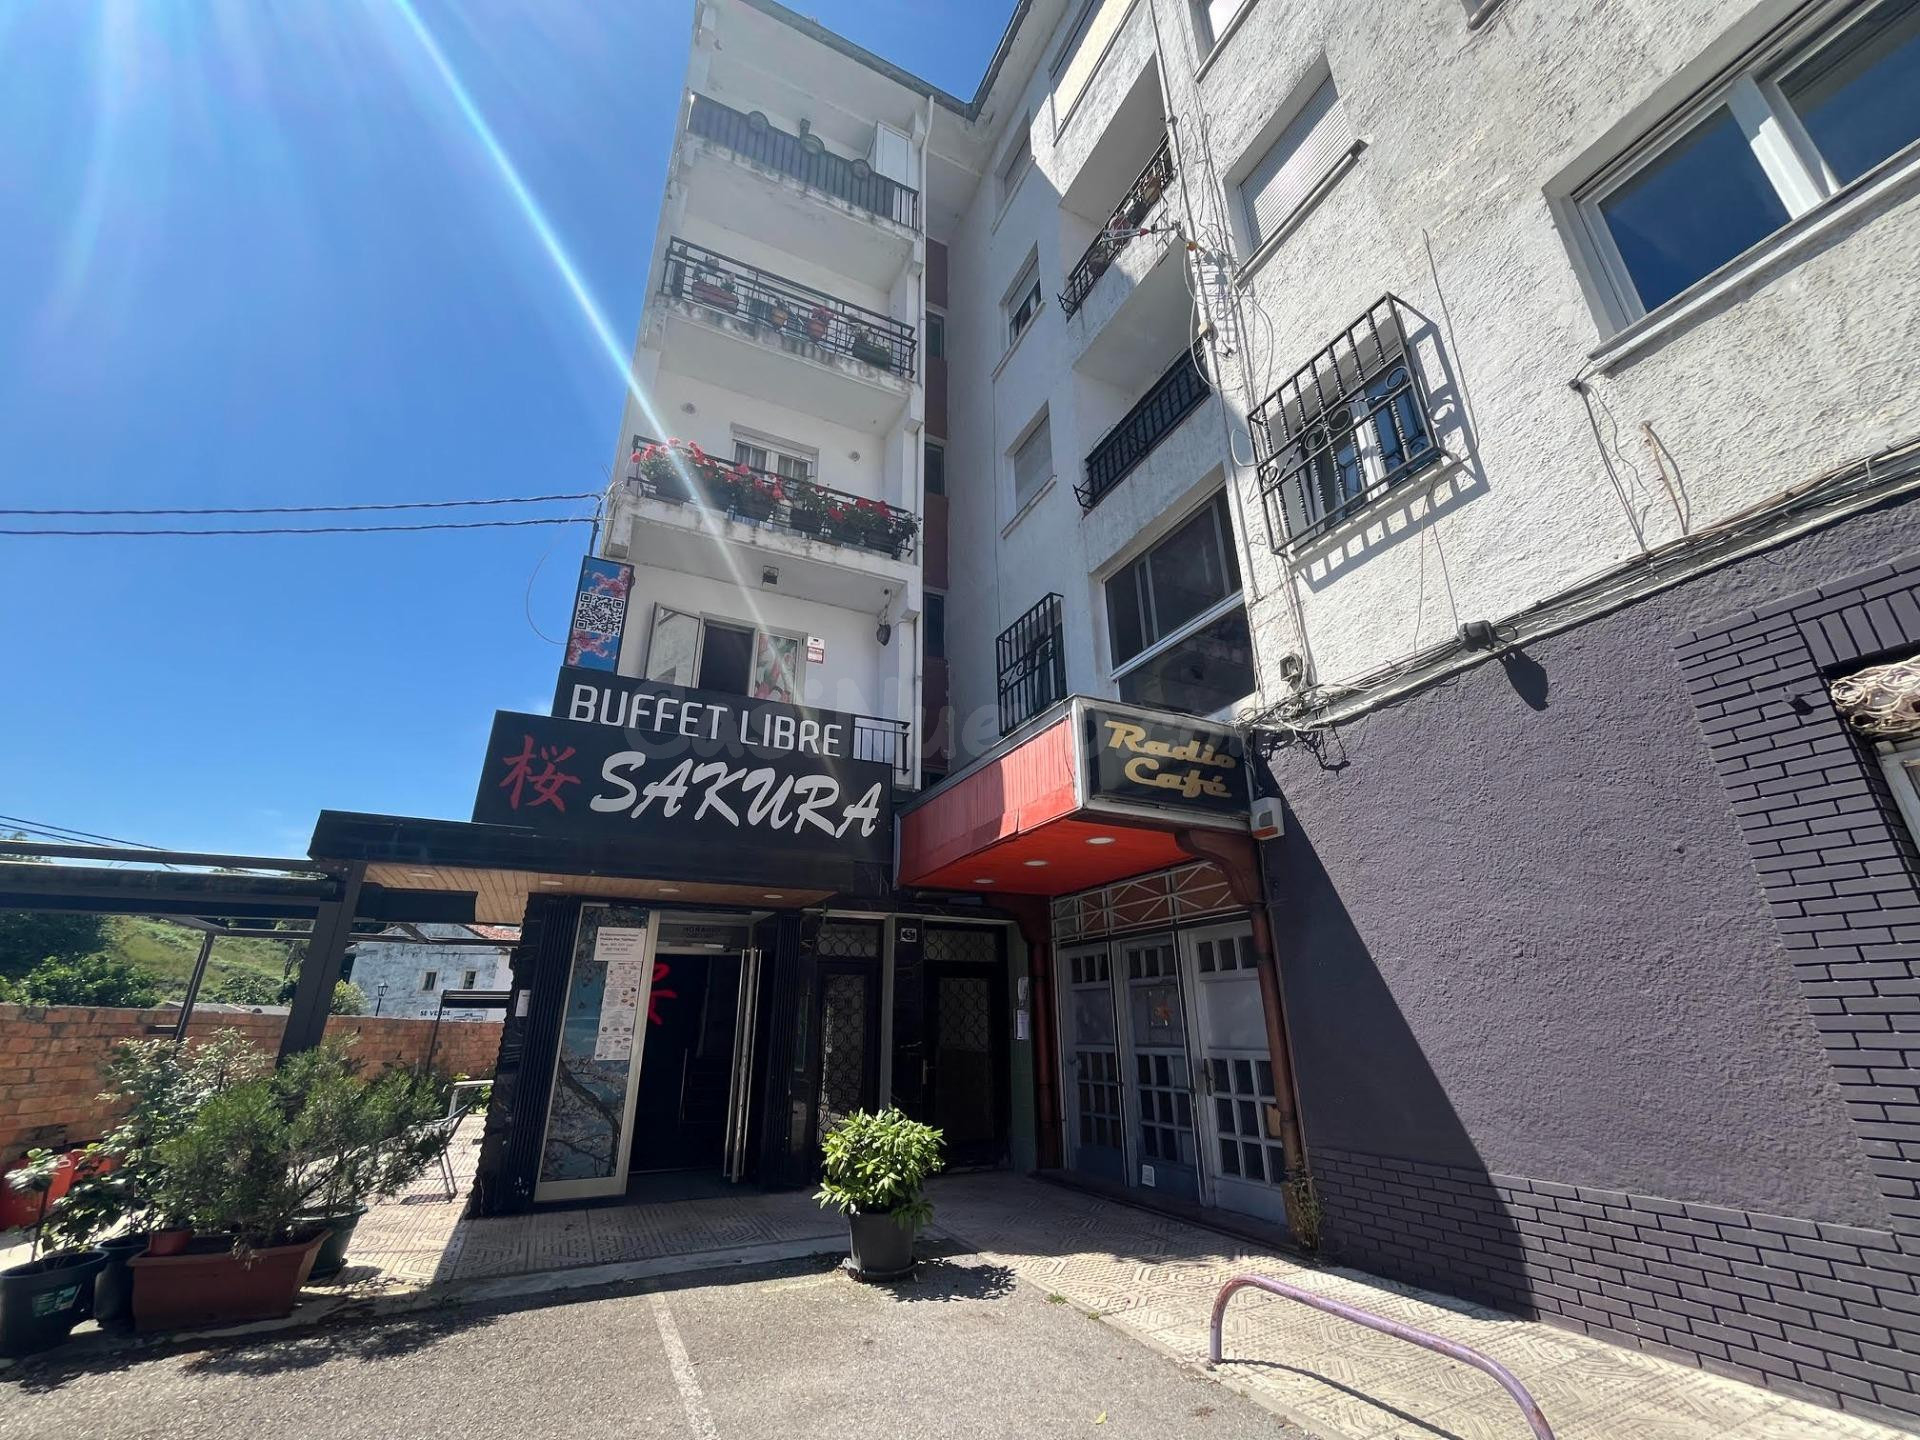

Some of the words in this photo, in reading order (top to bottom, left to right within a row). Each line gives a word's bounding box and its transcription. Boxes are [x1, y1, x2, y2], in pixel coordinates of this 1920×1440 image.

[569, 683, 731, 740] BUFFET
[739, 709, 842, 758] LIBRE
[1104, 720, 1236, 768] Radio
[500, 735, 581, 811] 桜
[590, 751, 882, 838] SAKURA
